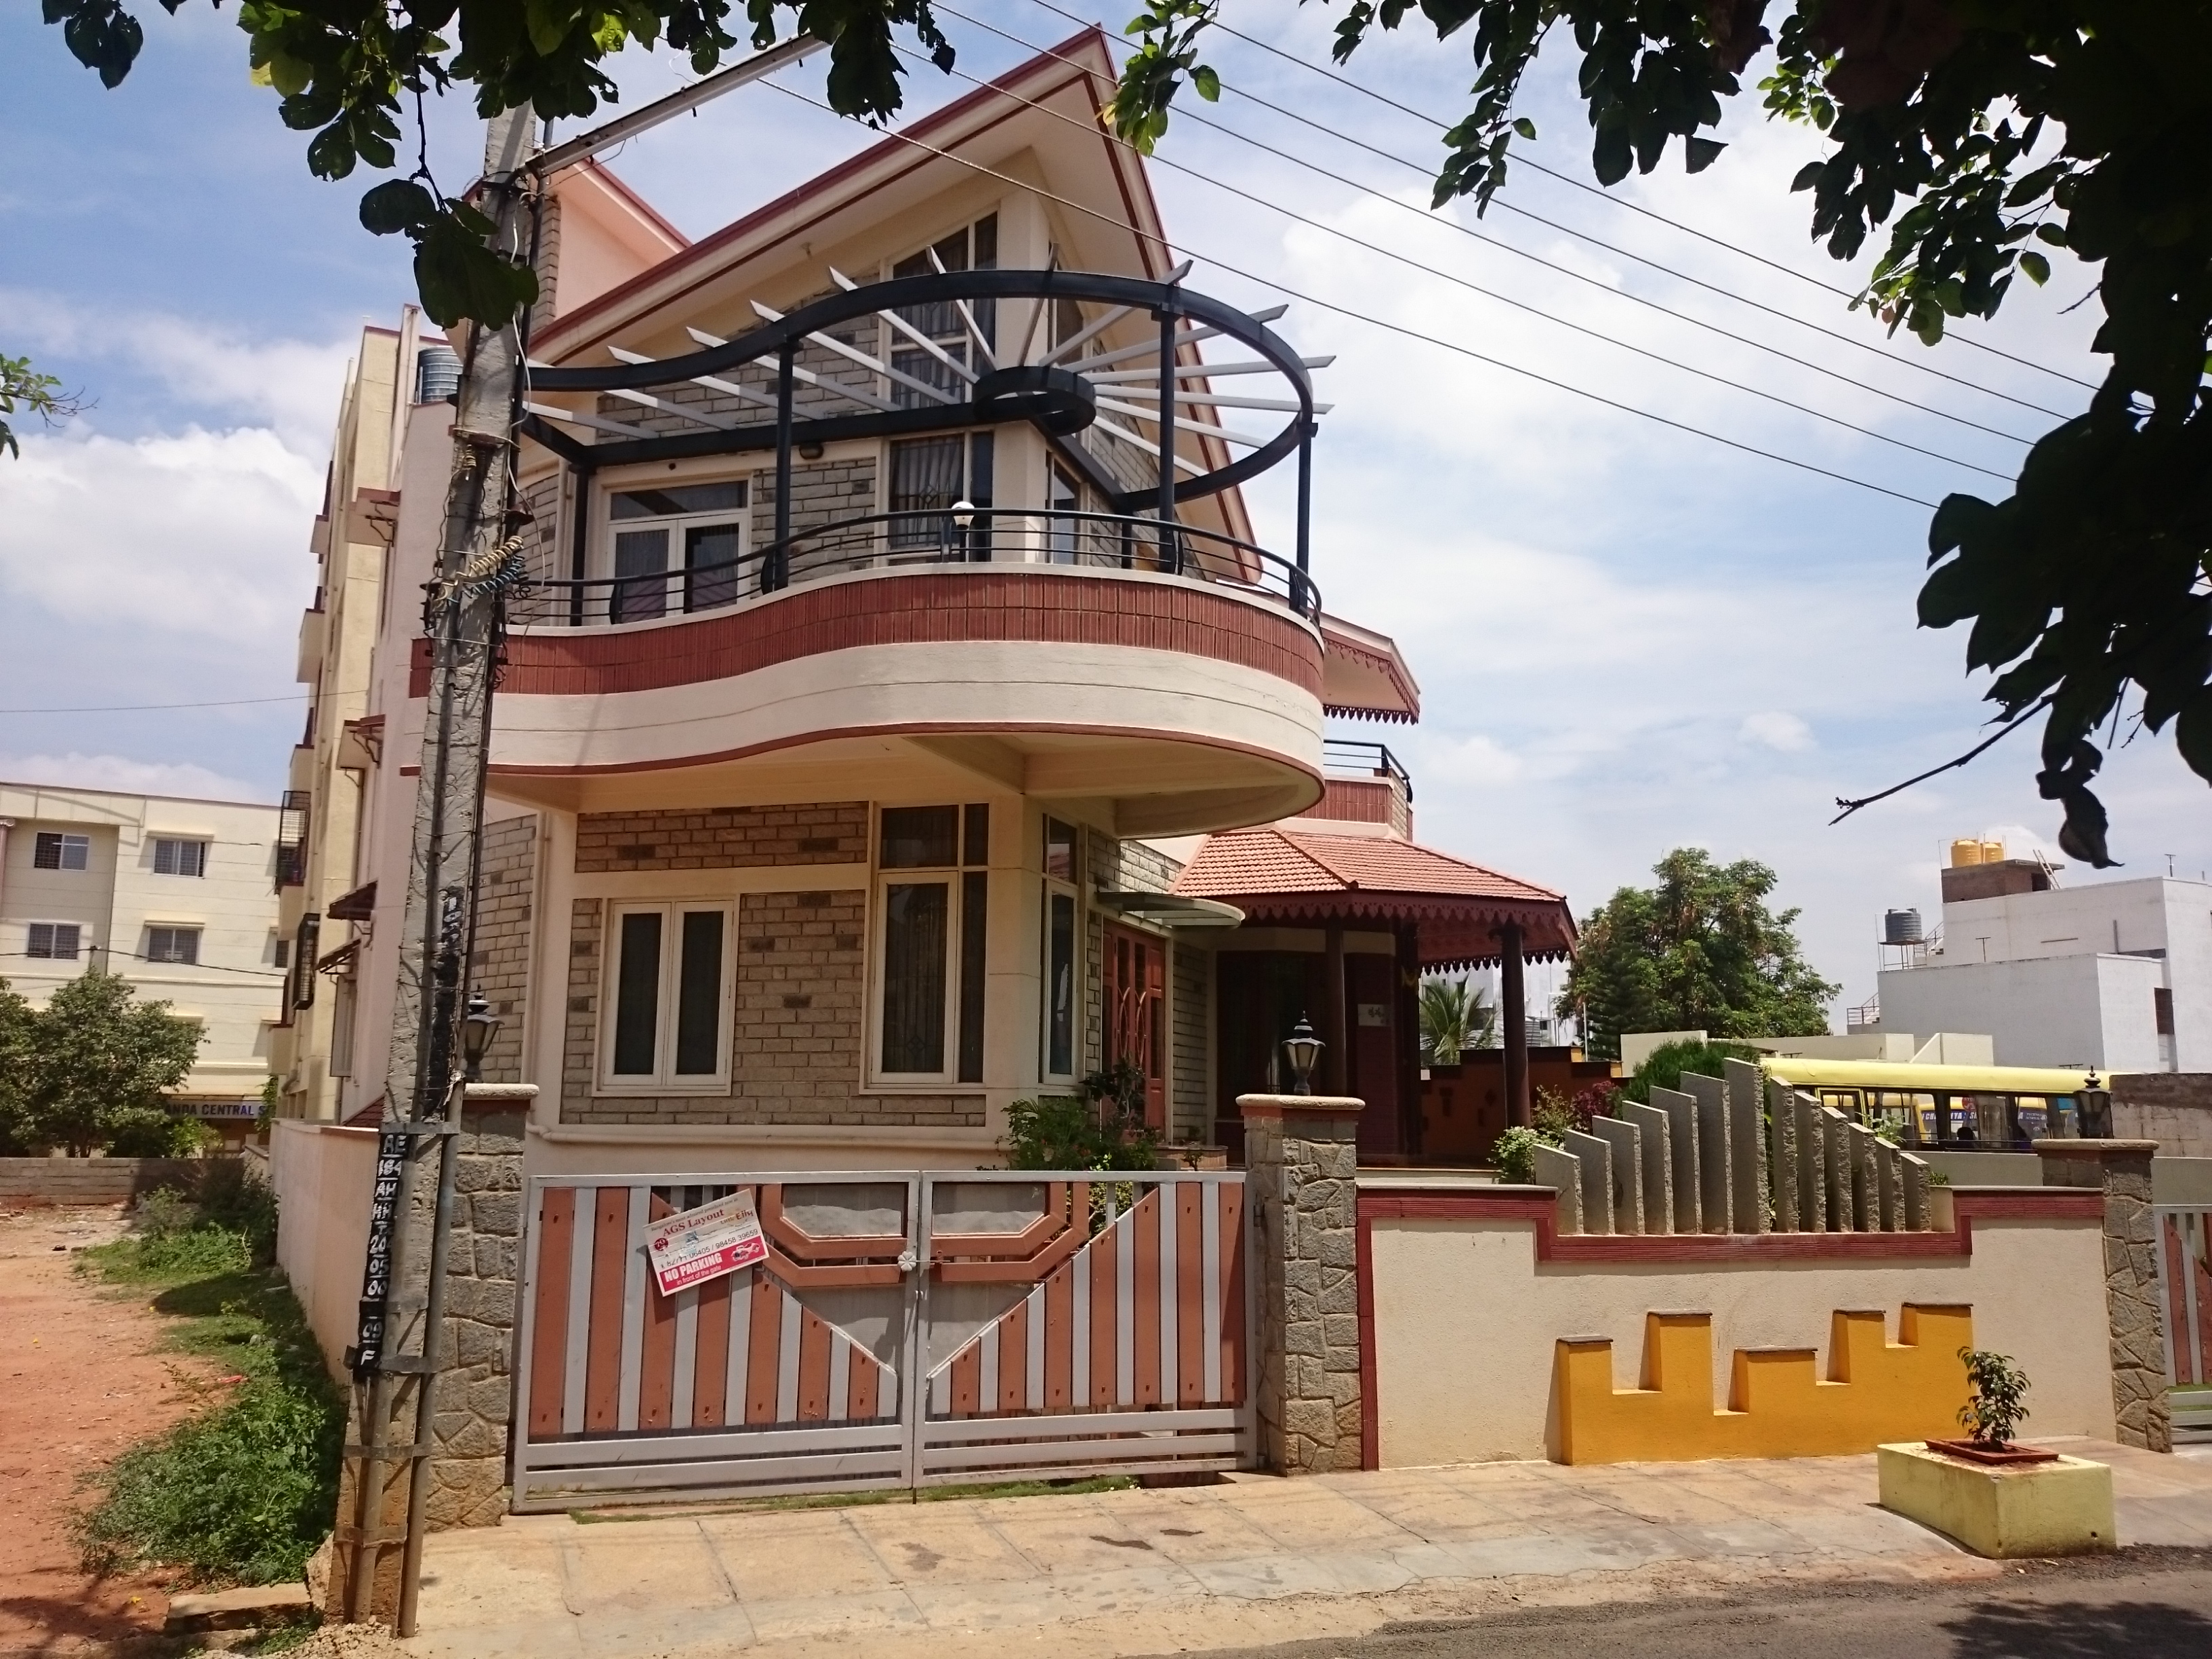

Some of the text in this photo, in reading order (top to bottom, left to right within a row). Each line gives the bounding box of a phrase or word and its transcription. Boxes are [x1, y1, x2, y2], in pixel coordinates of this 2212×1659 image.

[201, 1104, 254, 1115] CENTRAL
[663, 1222, 686, 1237] AGS
[687, 1209, 725, 1227] Layout
[716, 1237, 737, 1249] 98458
[737, 1228, 758, 1241] 39659
[664, 1268, 679, 1282] NO
[679, 1252, 723, 1277] PARKING
[682, 1275, 695, 1283] front
[695, 1271, 701, 1279] of
[710, 1265, 722, 1274] gate
